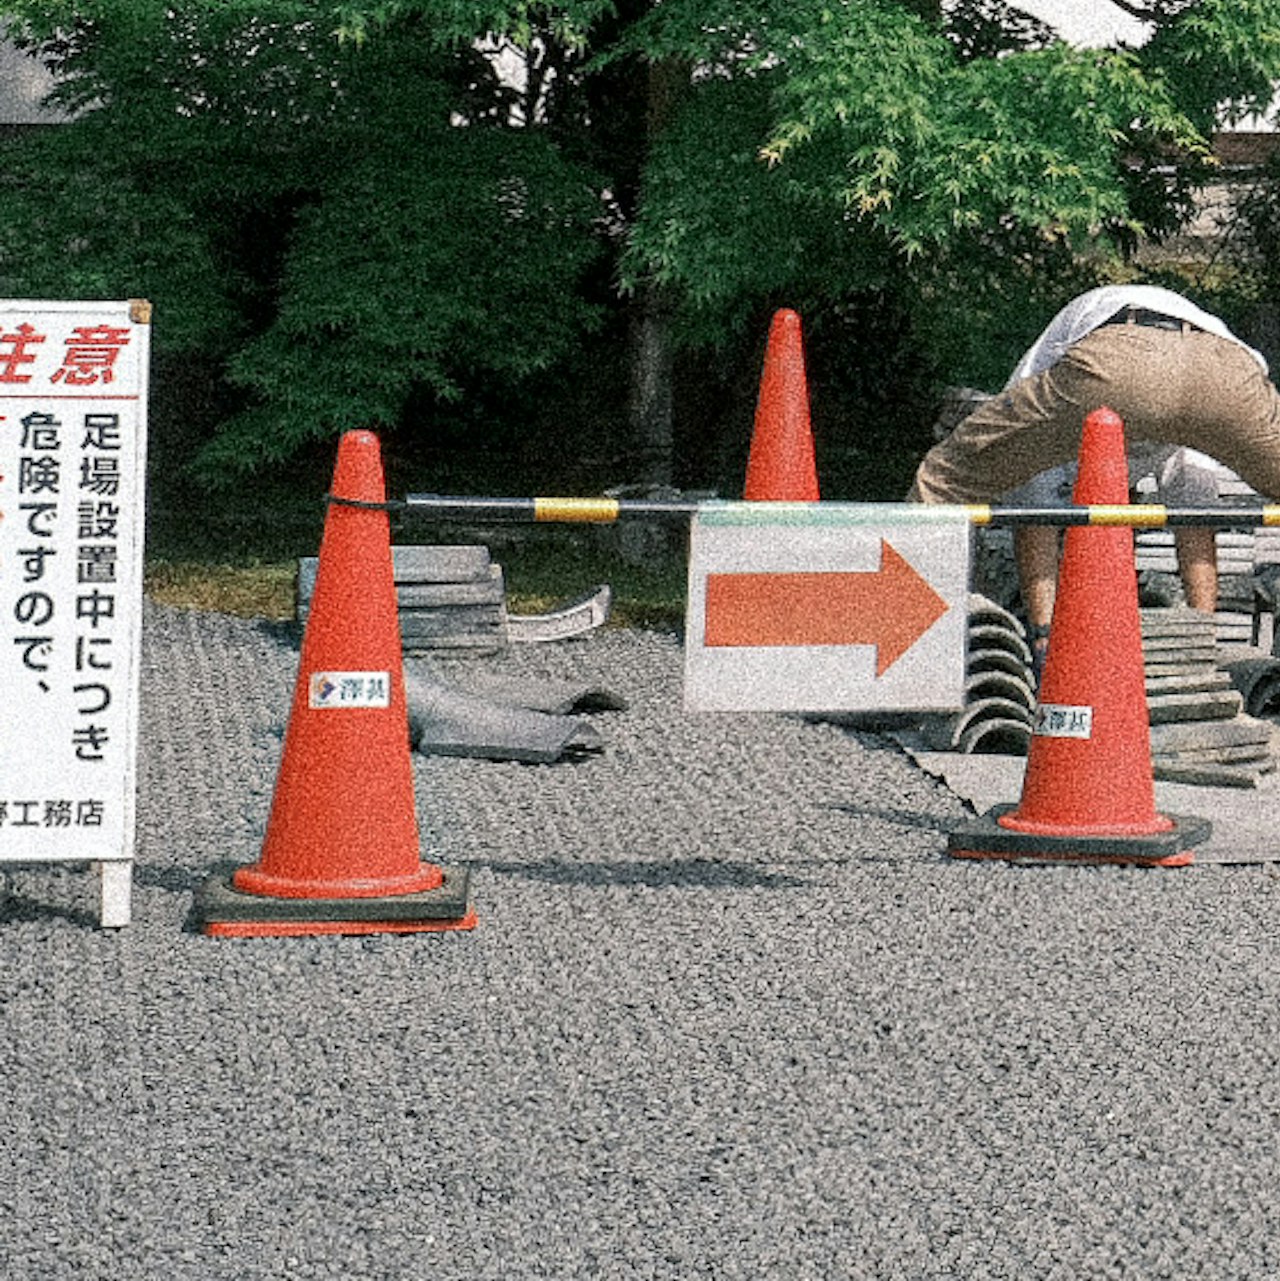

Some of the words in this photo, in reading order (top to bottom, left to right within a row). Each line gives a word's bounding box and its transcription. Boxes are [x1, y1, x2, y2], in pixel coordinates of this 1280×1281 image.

[14, 411, 62, 693] 危険ですので、
[71, 413, 121, 762] 足場設置中につき
[0, 797, 105, 828] 工務店
